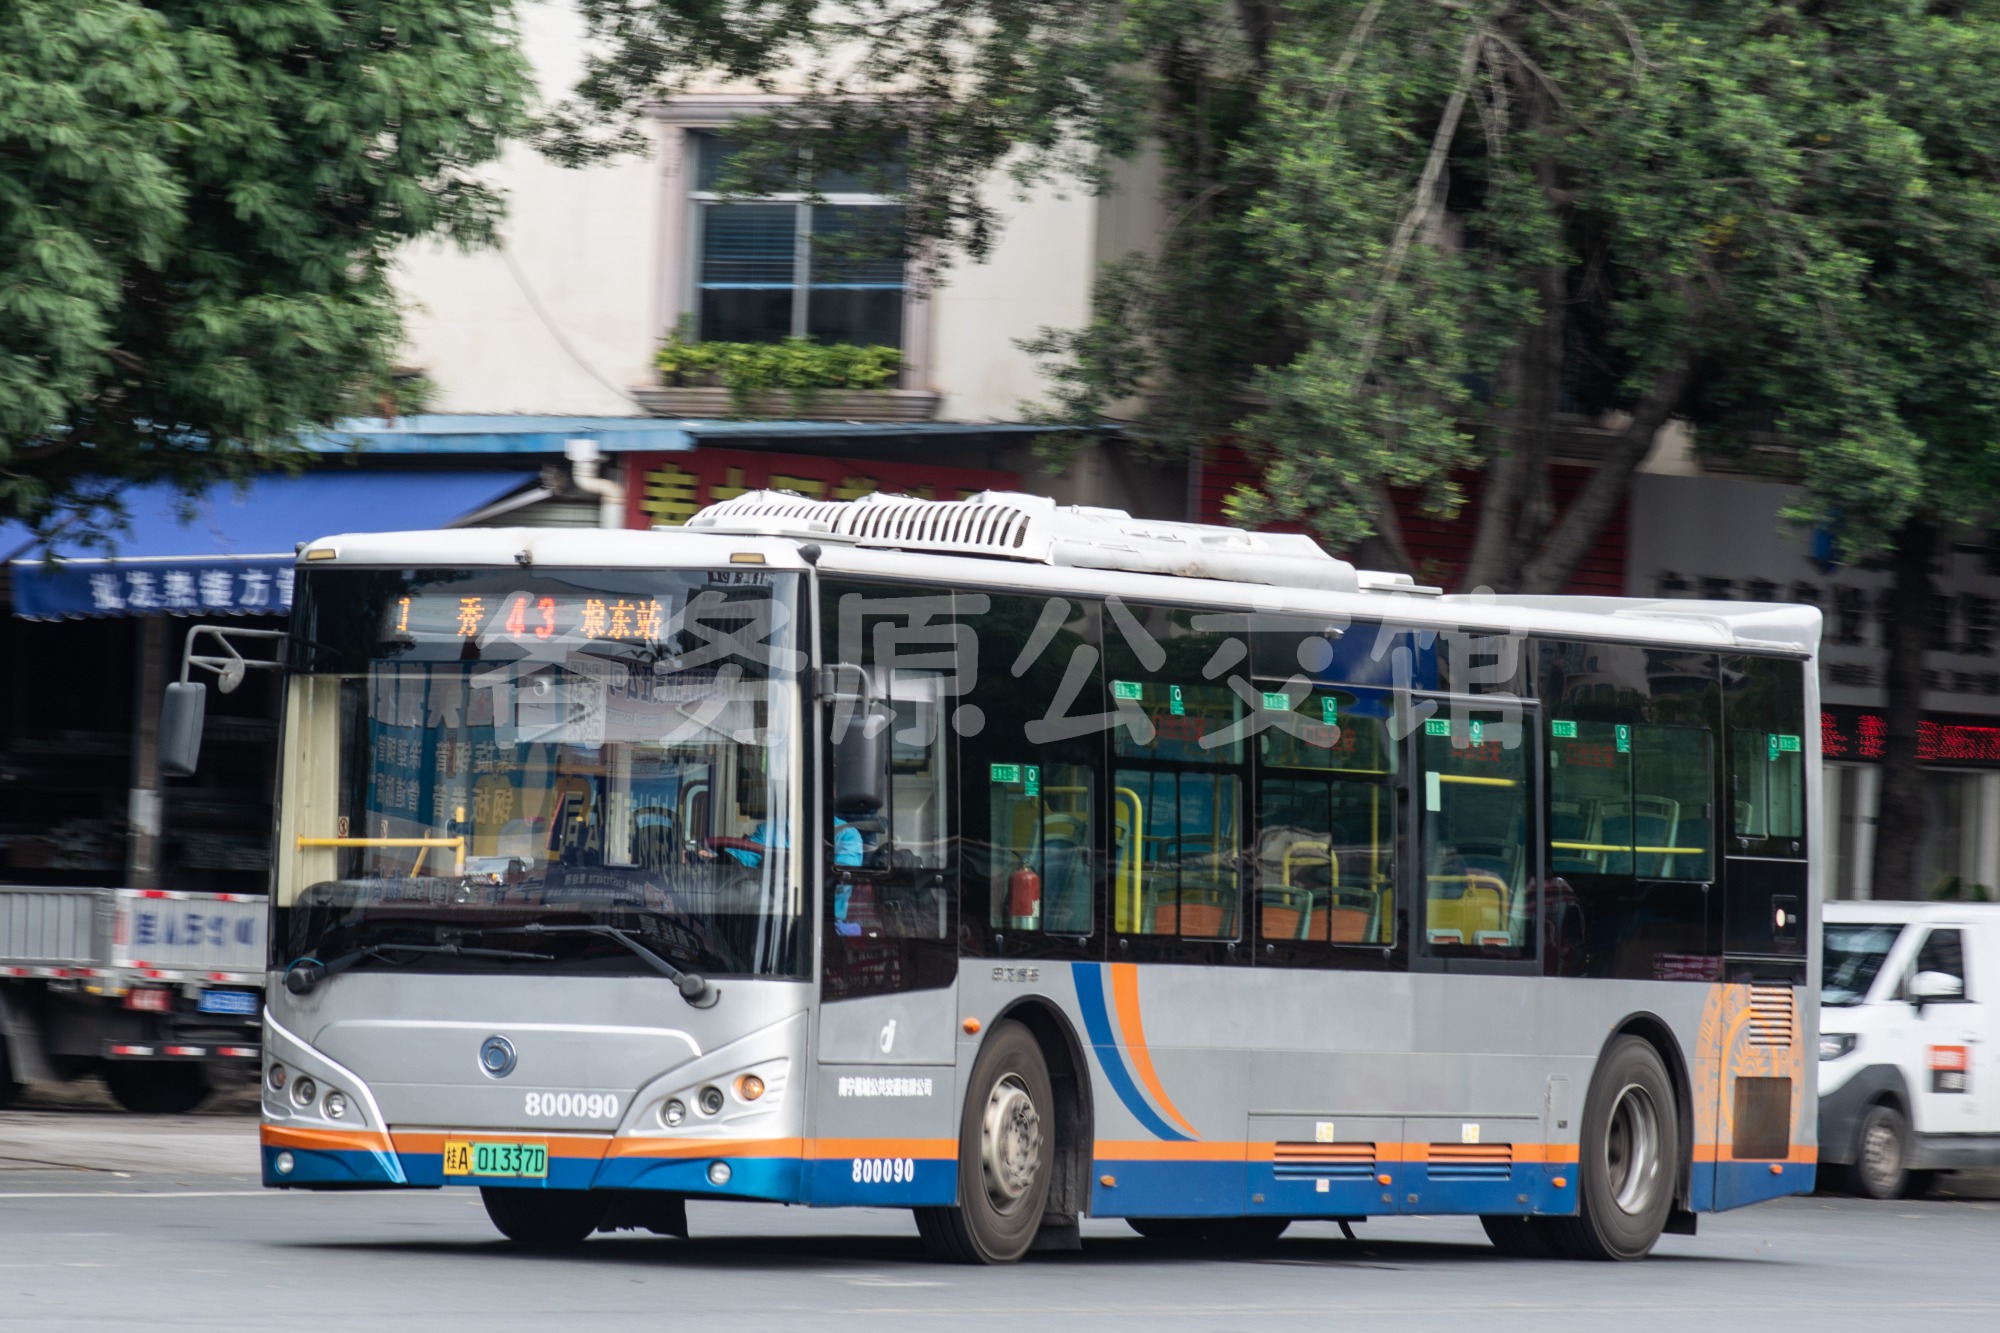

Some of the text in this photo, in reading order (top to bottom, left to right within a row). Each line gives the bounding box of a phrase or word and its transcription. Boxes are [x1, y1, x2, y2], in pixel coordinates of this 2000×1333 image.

[505, 597, 557, 638] 43
[524, 1091, 620, 1119] 800090
[851, 1157, 915, 1184] 800090
